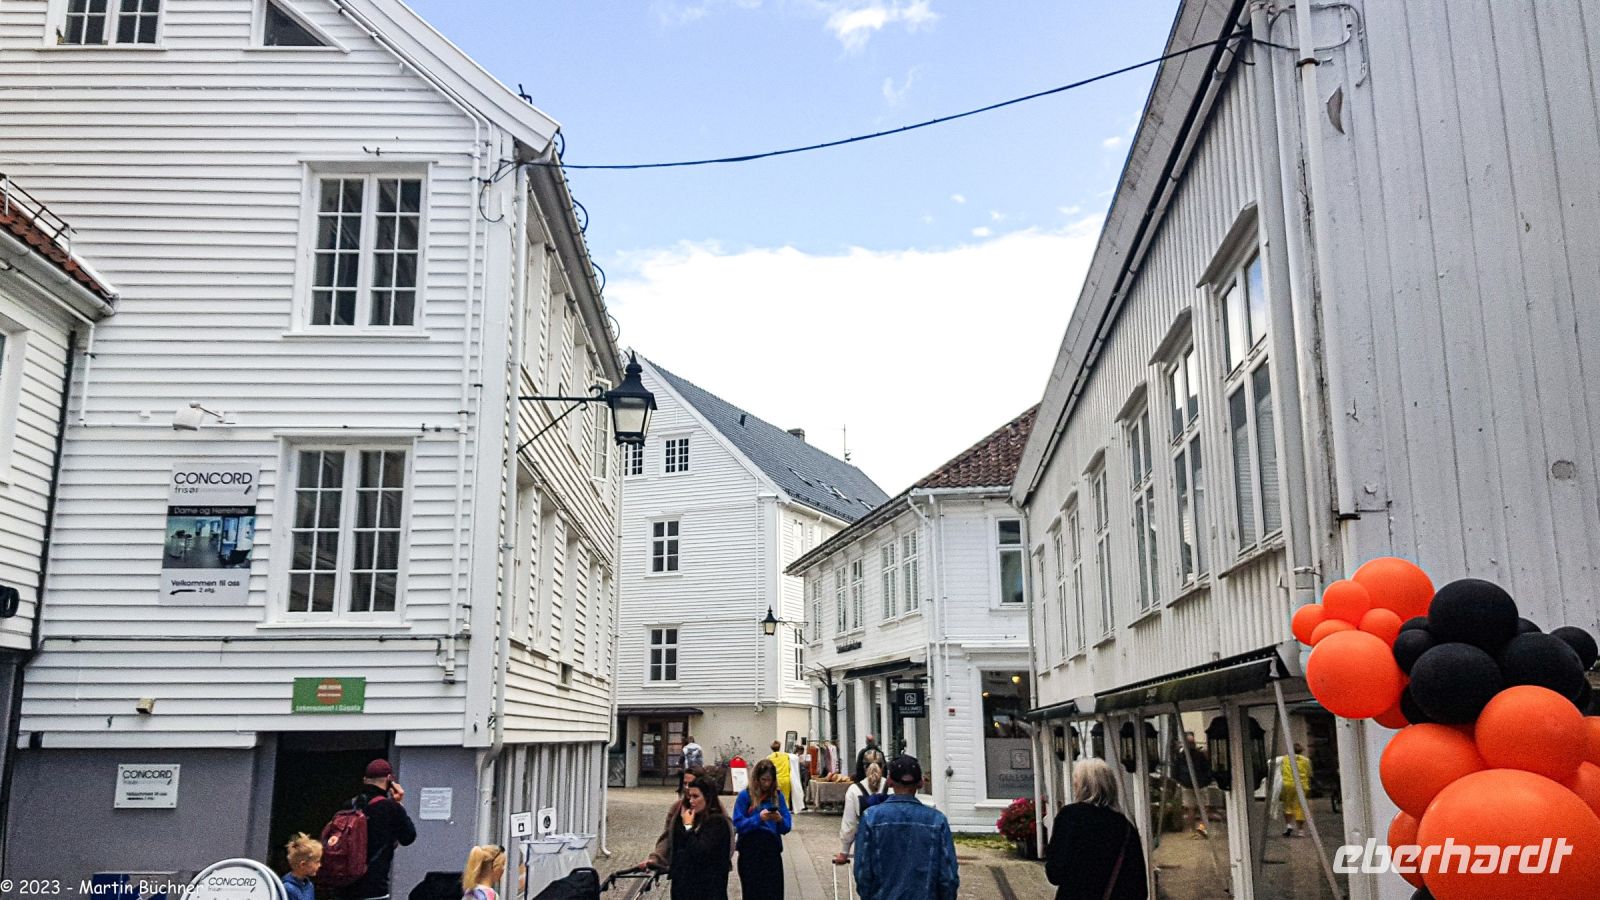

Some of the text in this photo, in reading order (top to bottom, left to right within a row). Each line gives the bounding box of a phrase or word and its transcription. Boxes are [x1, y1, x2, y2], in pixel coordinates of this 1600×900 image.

[174, 472, 252, 484] CONCORD
[174, 485, 199, 494] frisør
[123, 770, 173, 778] CONCORD
[208, 877, 257, 886] CONCORD
